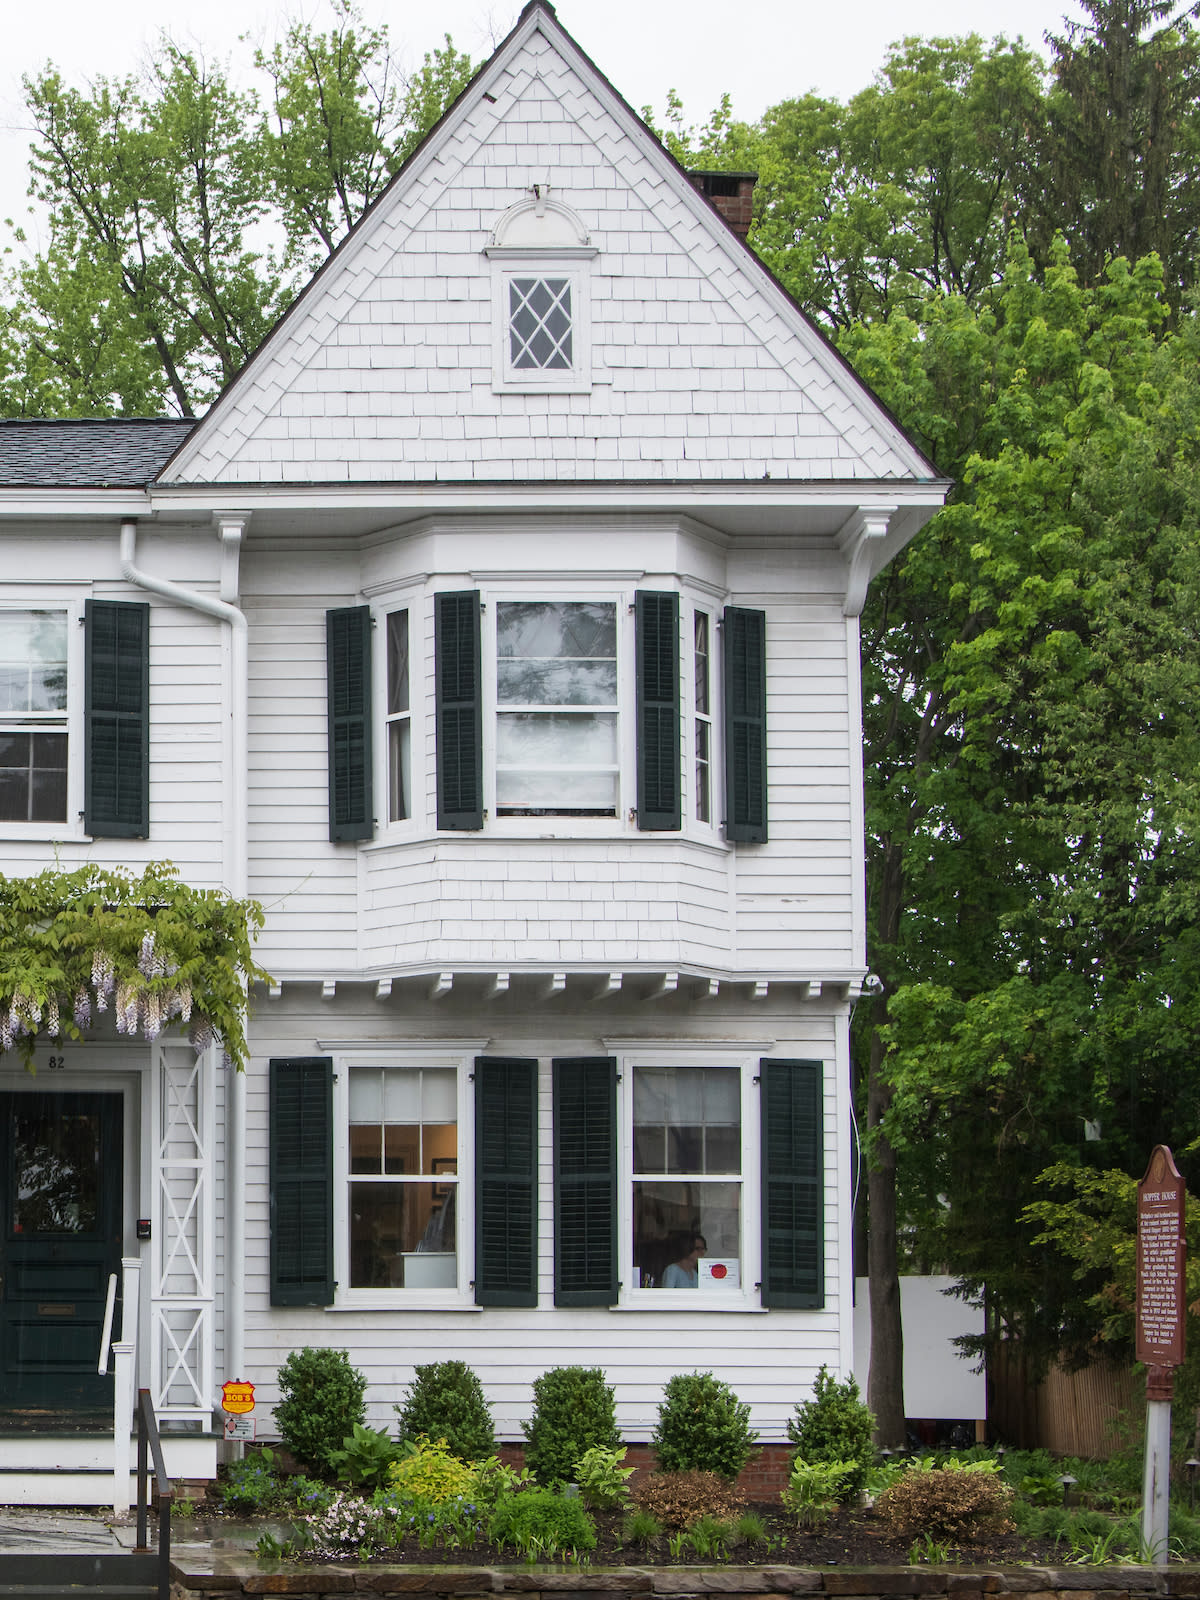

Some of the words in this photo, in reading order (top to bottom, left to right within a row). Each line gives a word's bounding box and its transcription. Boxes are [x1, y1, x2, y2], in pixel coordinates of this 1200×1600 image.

[49, 1056, 64, 1068] 82
[1143, 1193, 1160, 1201] HOPPER
[1161, 1191, 1176, 1200] HOUSE
